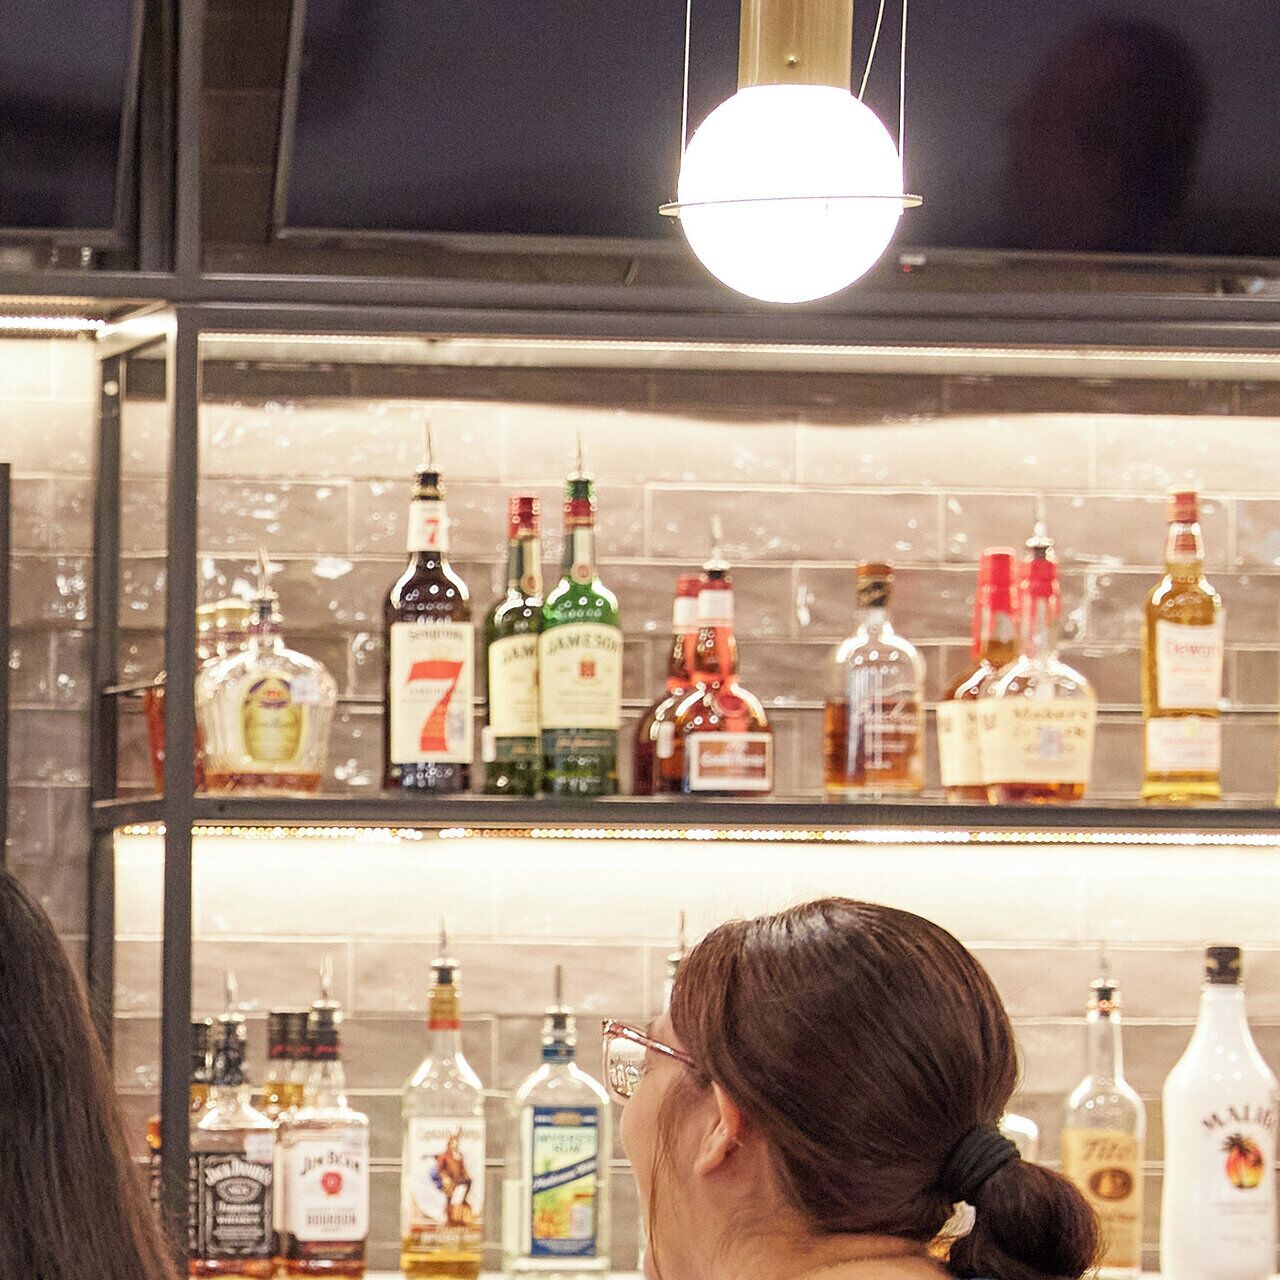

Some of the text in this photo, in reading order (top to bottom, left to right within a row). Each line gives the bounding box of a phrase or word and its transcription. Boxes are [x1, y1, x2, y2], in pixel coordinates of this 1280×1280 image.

[424, 518, 440, 545] 7
[546, 634, 619, 655] JAMESON
[406, 660, 465, 752] 7
